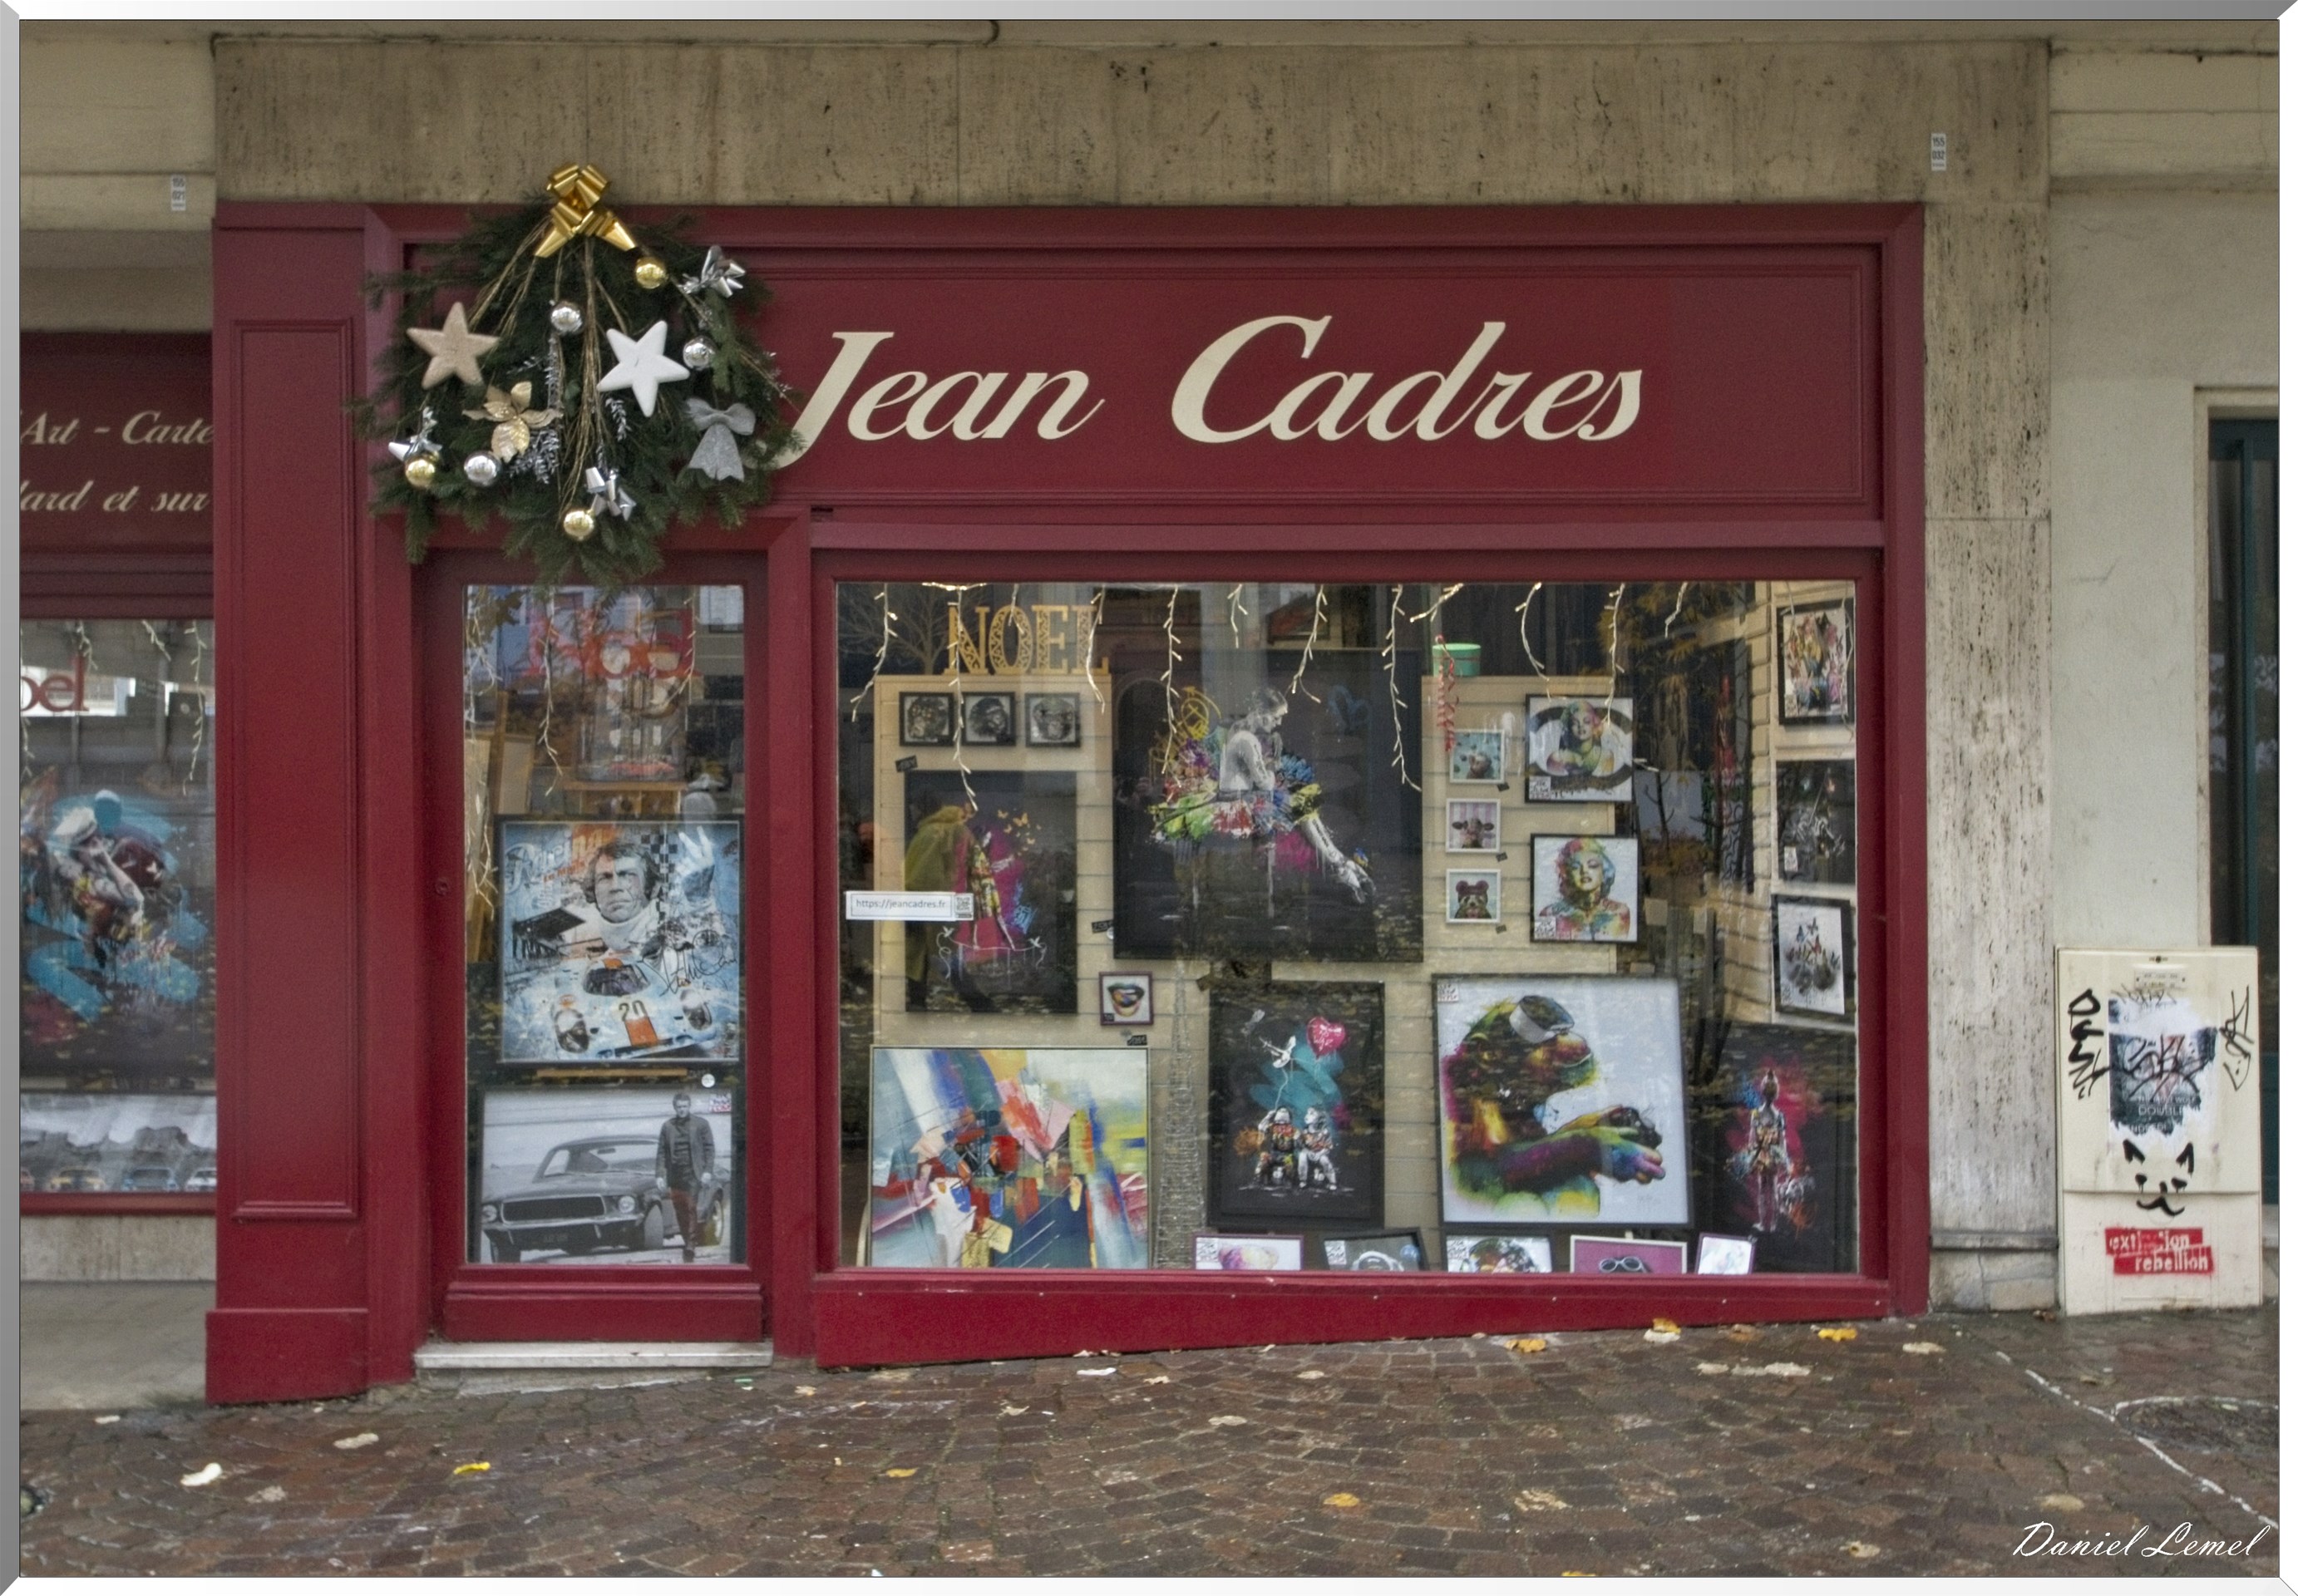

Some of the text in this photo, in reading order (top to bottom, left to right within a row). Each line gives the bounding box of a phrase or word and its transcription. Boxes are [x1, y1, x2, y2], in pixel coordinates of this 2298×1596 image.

[770, 315, 1643, 470] Jean Cadres
[103, 485, 140, 511] et
[150, 492, 210, 511] sur
[941, 604, 1110, 676] NOEL
[856, 899, 946, 909] https://jeancadres.fr
[2135, 1249, 2208, 1273] rebellion
